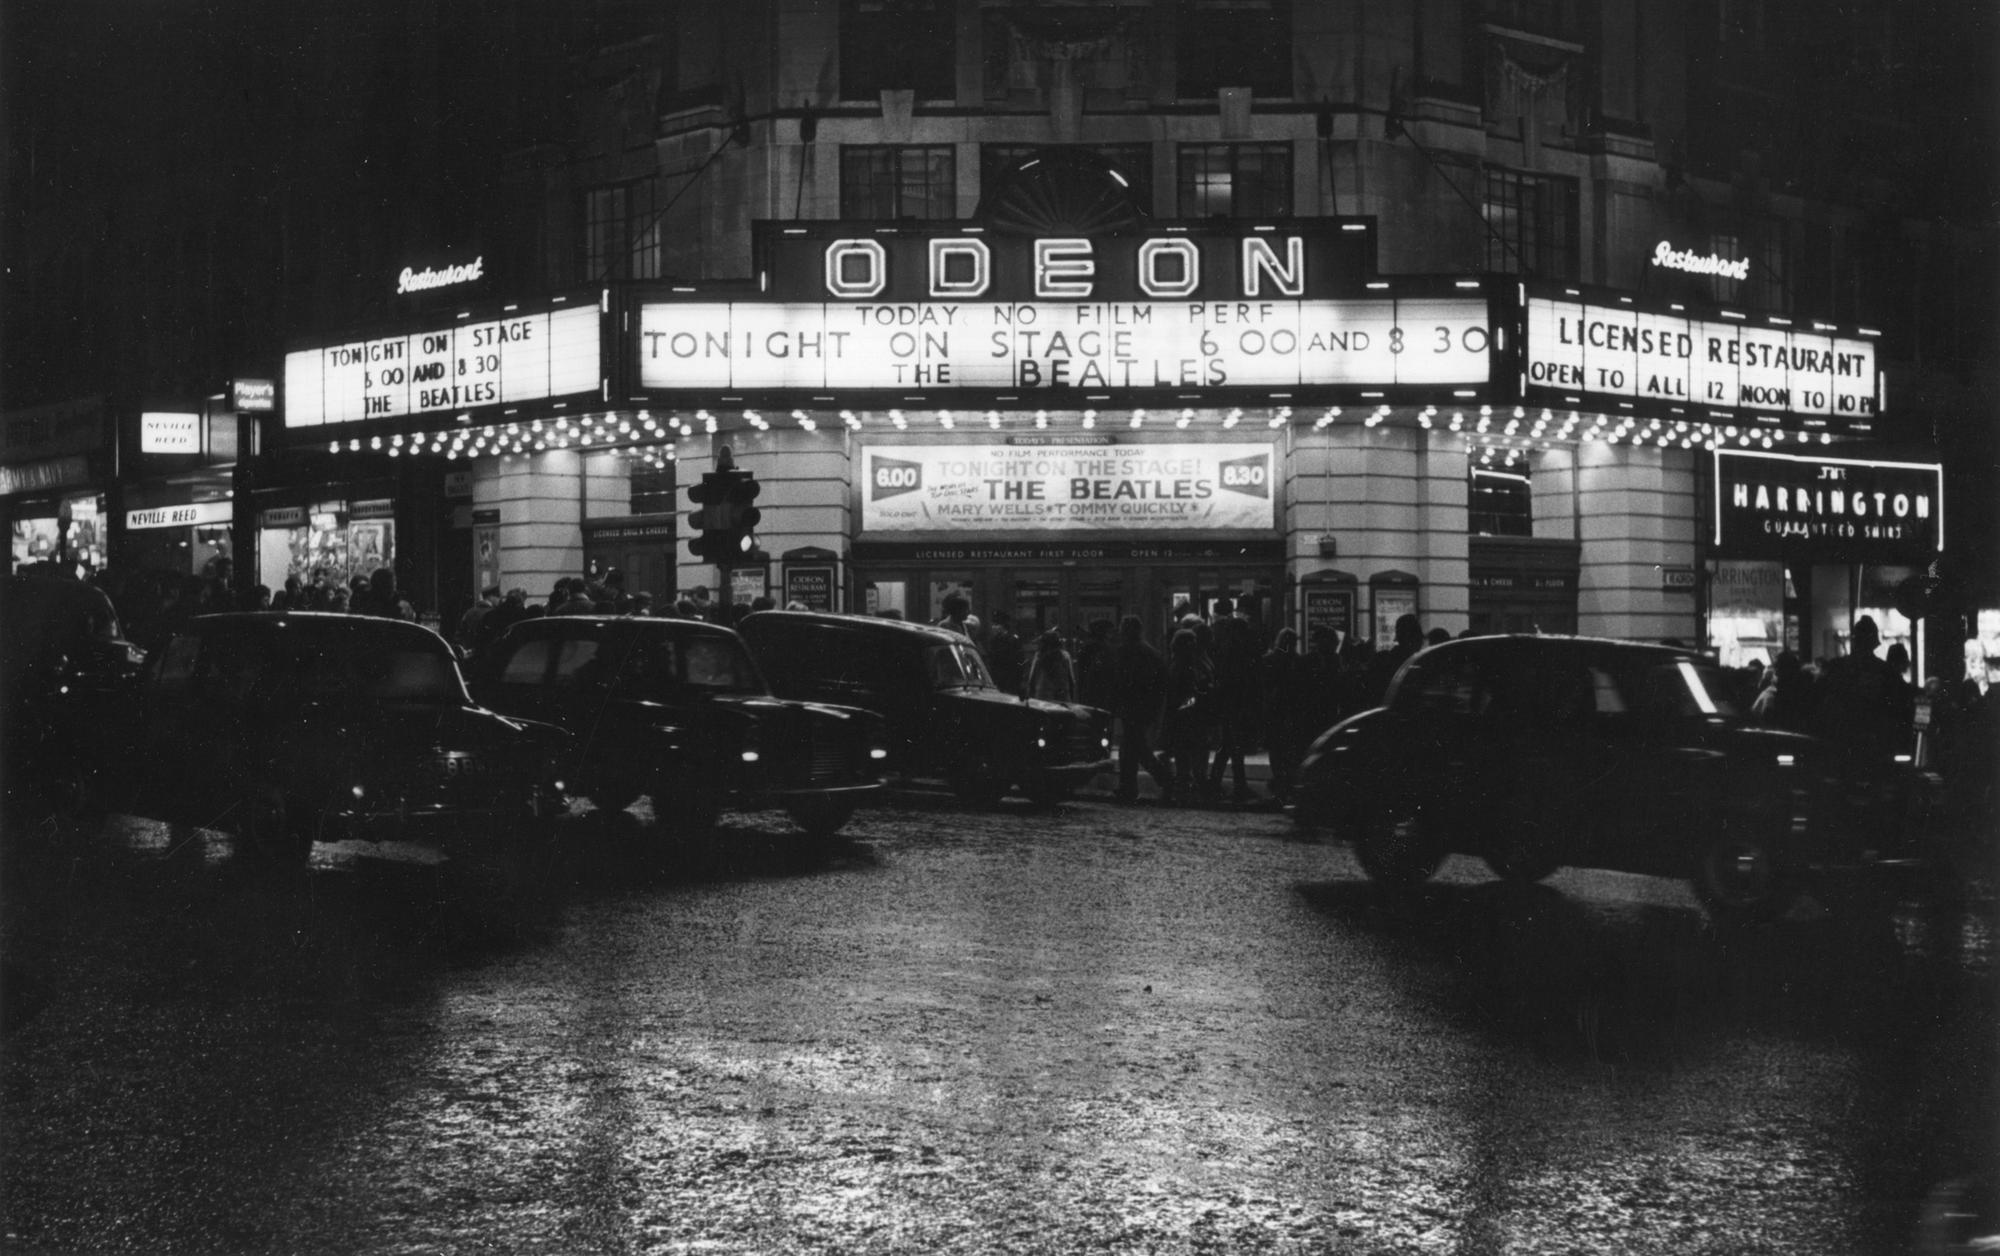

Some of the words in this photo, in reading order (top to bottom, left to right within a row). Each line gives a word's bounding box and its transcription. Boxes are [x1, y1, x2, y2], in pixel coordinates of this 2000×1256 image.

[825, 237, 1304, 297] ODEON
[1652, 240, 1749, 280] Restaurant
[397, 256, 483, 294] Restaurant
[855, 305, 959, 326] TODAY
[994, 305, 1037, 325] NO
[1077, 304, 1152, 325] FILM
[1190, 303, 1274, 324] PERF
[330, 340, 405, 367] TONIGHT
[423, 334, 448, 355] ON
[473, 321, 533, 347] STAGE
[643, 331, 851, 358] TONIGHT
[889, 331, 949, 358] ON
[992, 330, 1133, 358] STAGE
[1200, 329, 1219, 357] 6
[1239, 329, 1296, 356] 00
[1308, 330, 1370, 353] AND
[1388, 326, 1404, 354] 8
[1433, 326, 1490, 354] 30
[1560, 317, 1692, 359] LICENSED
[1707, 337, 1865, 378] RESTAURANT
[381, 367, 404, 386] 00
[412, 362, 445, 383] AND
[458, 357, 466, 376] 8
[475, 354, 499, 373] 30
[892, 363, 951, 384] THE
[1020, 359, 1227, 387] BEATLES
[1530, 361, 1584, 385] OPEN
[1598, 368, 1625, 388] TO
[1647, 375, 1686, 397] ALL
[1707, 381, 1724, 400] 12
[1741, 385, 1791, 407] NOON
[1803, 391, 1825, 409] TO
[1838, 394, 1856, 411] 10
[363, 395, 392, 414] THE
[420, 382, 495, 409] BEATLES
[147, 422, 192, 430] NEVILLE
[1037, 449, 1108, 457] PERFORMANCE
[1115, 449, 1145, 457] TODAY
[876, 467, 917, 487] 6.00
[938, 461, 1032, 477] TONIGHT
[1035, 461, 1067, 476] ON
[1074, 460, 1116, 476] THE
[1121, 459, 1201, 476] STAGE!
[1223, 465, 1265, 486] 8.30
[984, 479, 1046, 501] THE
[1070, 478, 1213, 500] BEATLES
[1733, 483, 1929, 518] HARRINGTON
[131, 511, 166, 526] NEVILLE
[172, 508, 197, 522] REED
[937, 503, 984, 515] MARY
[989, 503, 1044, 515] WELLS
[1120, 501, 1187, 515] QUICKLY
[916, 550, 967, 558] LICENSED
[971, 550, 1032, 558] RESTAURANT
[1040, 550, 1064, 558] FIRST
[1072, 550, 1104, 558] FLOOR
[1131, 549, 1158, 558] OPEN
[793, 575, 825, 583] ODEON
[1711, 568, 1782, 585] ARRINGTON
